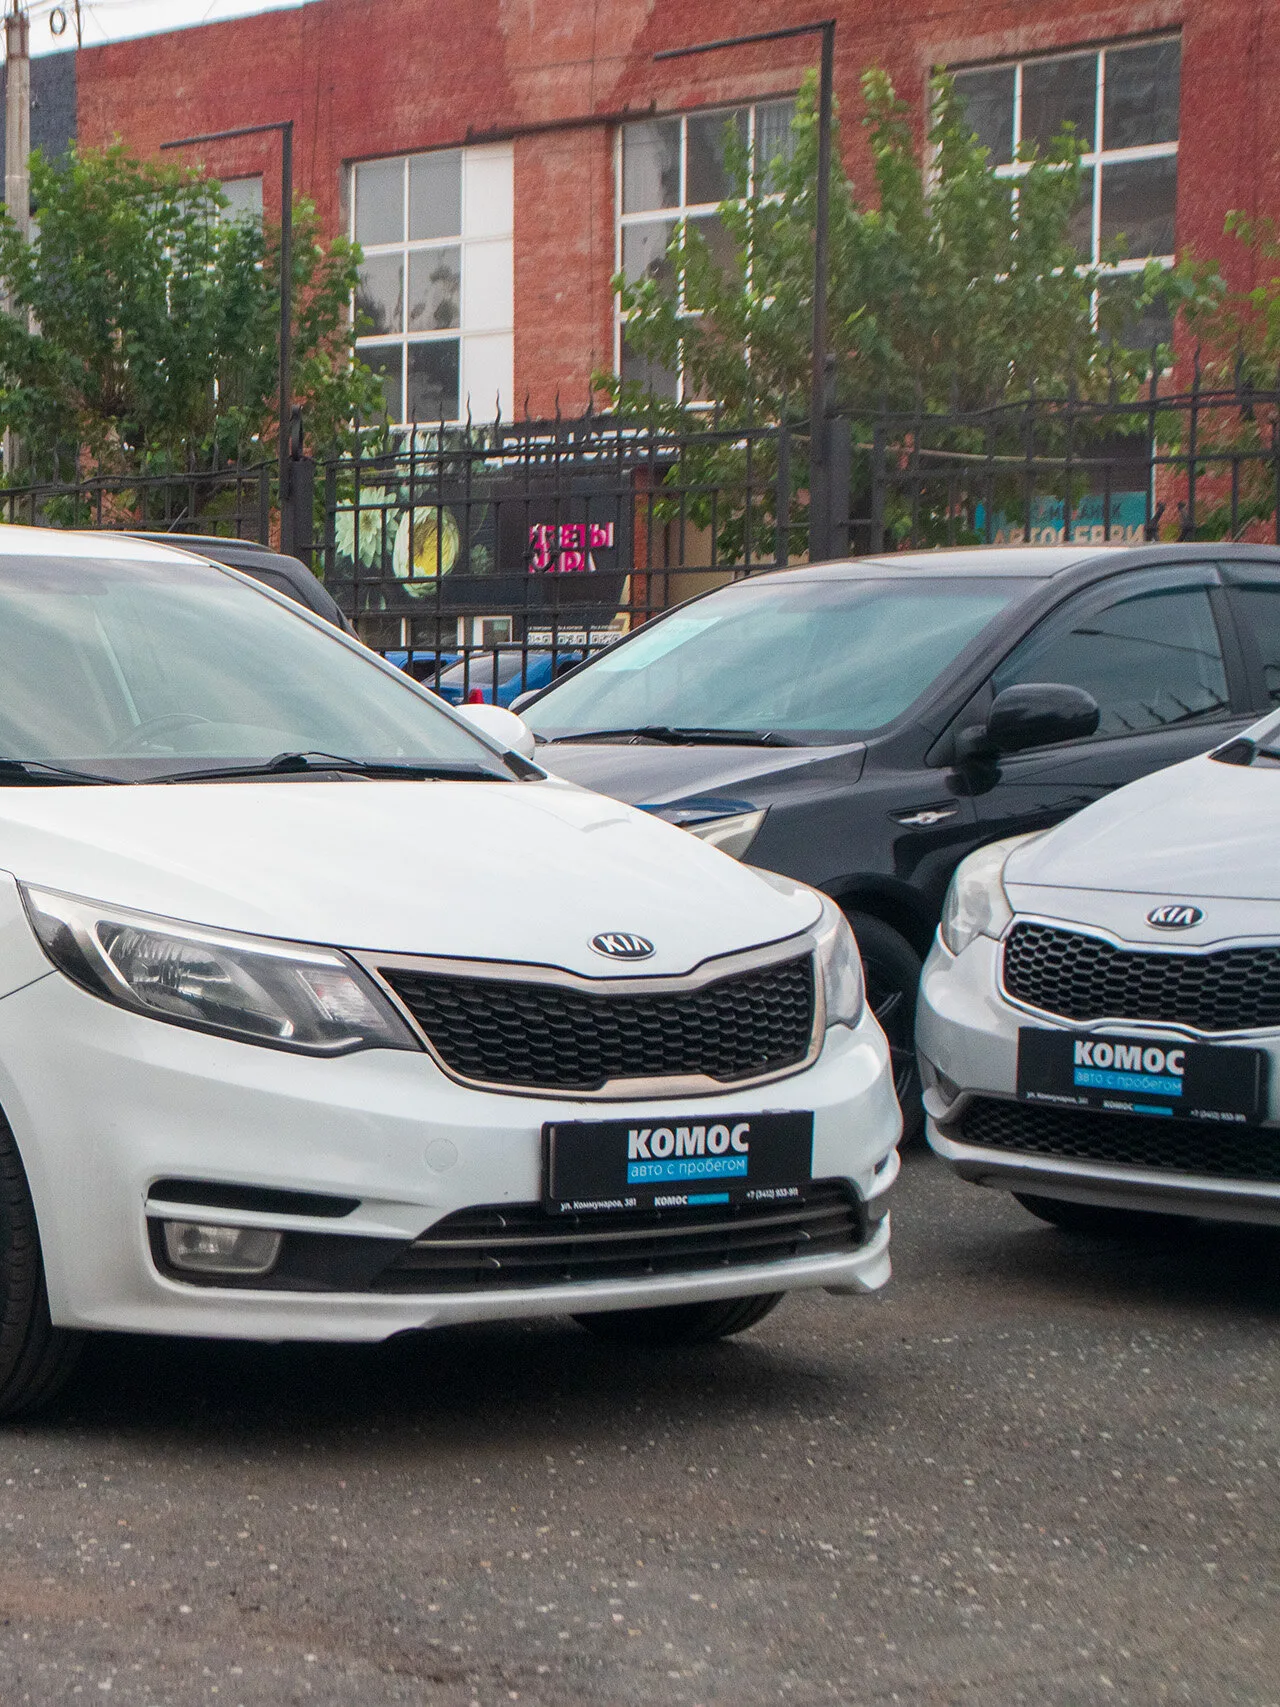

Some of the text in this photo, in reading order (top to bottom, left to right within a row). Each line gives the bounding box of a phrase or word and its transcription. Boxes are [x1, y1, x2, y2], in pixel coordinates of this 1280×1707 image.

[1150, 906, 1194, 925] KIA
[598, 935, 654, 952] KIA
[1074, 1040, 1185, 1075] КОМОС
[1076, 1072, 1103, 1084] авто
[1117, 1076, 1182, 1091] пробегом
[627, 1123, 750, 1159] КОМОС
[631, 1158, 745, 1177] авто с пробегом
[654, 1195, 688, 1207] КОМОС
